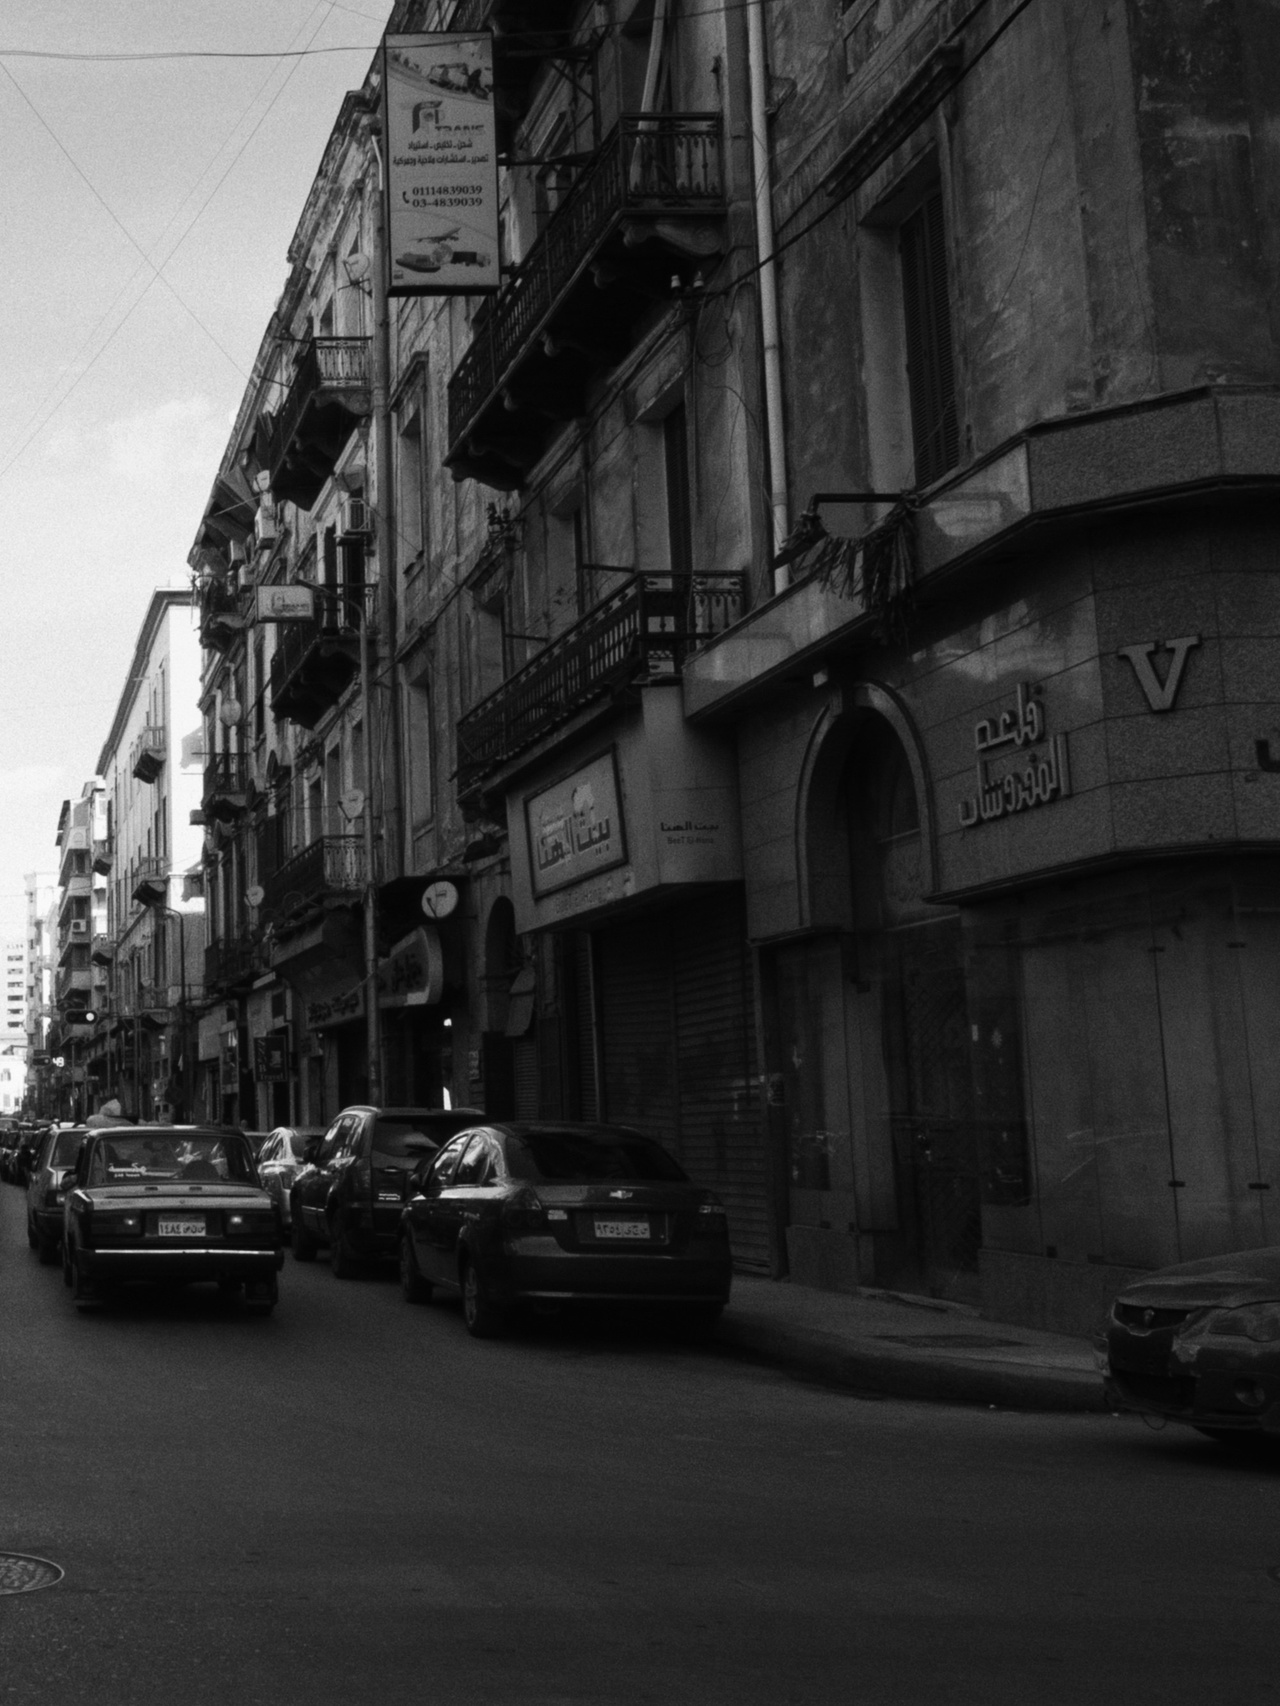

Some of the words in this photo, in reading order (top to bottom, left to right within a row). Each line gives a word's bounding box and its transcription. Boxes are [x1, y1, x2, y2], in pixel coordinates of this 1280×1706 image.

[411, 185, 483, 195] 01114839039
[411, 197, 483, 208] 03-4839039
[1118, 634, 1203, 714] V
